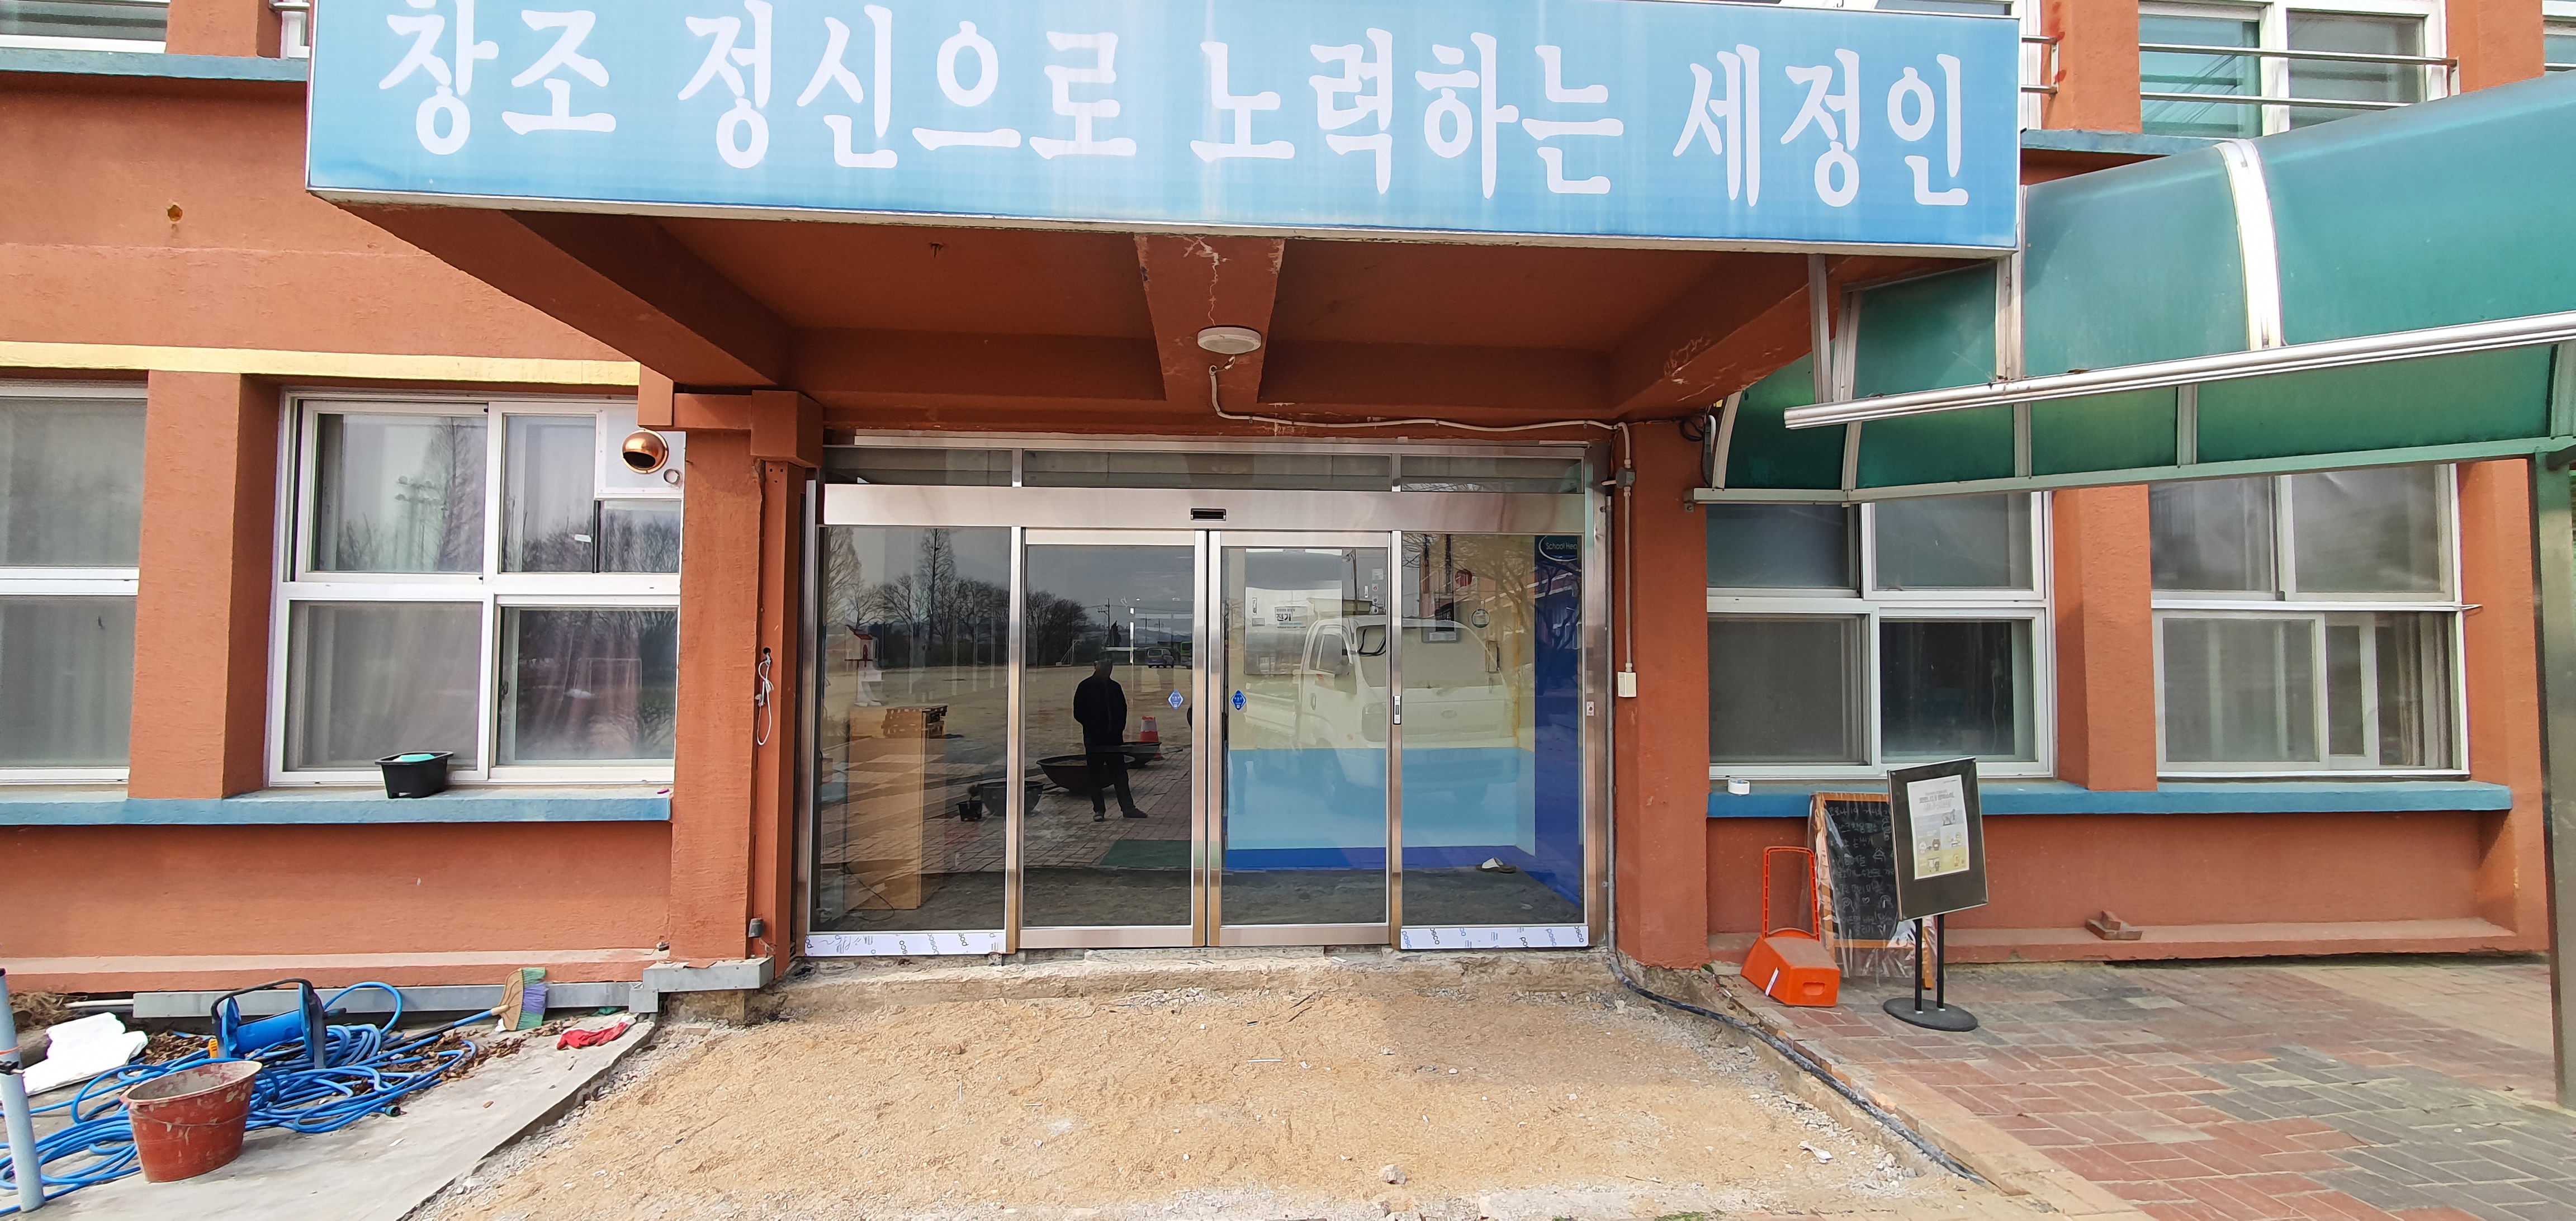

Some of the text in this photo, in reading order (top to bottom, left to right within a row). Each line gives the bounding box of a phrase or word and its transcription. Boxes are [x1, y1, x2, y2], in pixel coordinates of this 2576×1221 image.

[379, 0, 1969, 208] 창조 정신으로 노력하는 세정인
